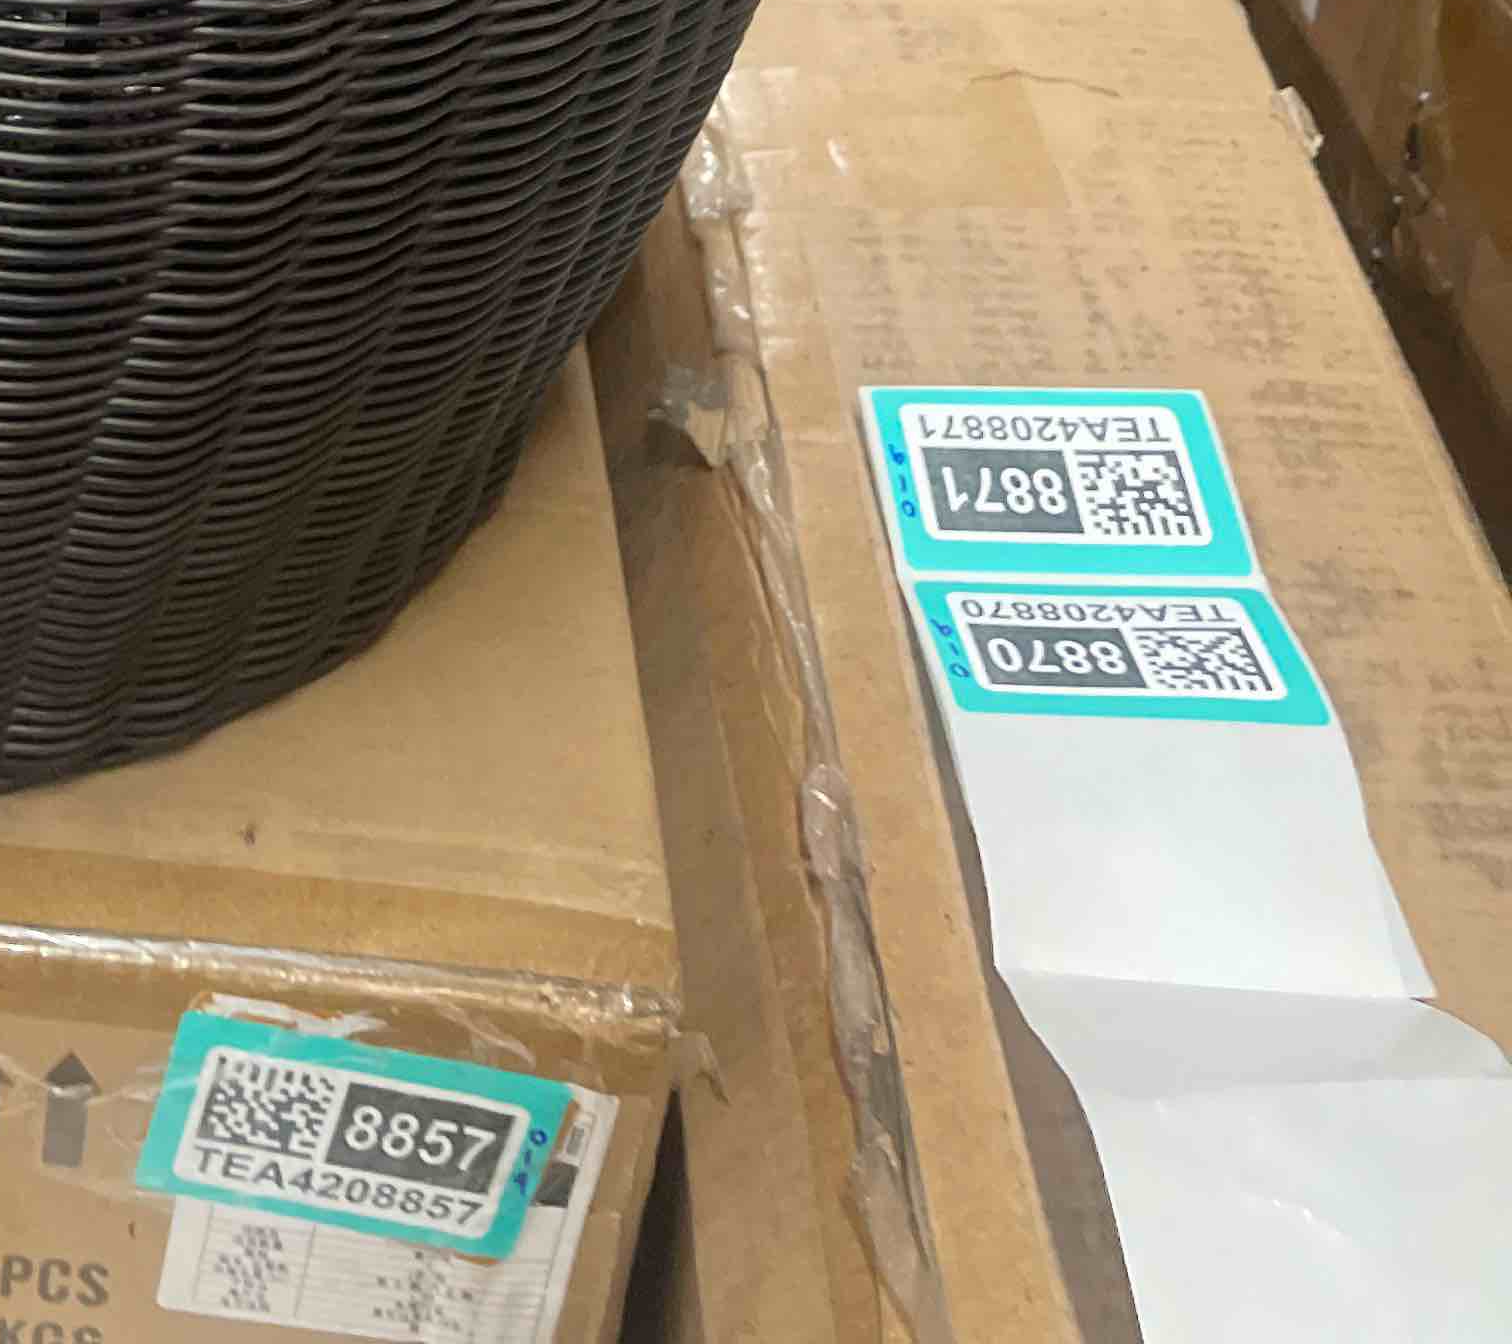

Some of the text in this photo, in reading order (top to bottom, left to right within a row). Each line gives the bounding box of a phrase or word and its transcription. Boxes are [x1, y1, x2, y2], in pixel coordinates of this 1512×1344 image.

[919, 414, 1172, 443] TEA4208871
[940, 465, 1067, 515] 8871
[962, 599, 1237, 624] TEA4208870
[988, 637, 1128, 676] 8870
[342, 1103, 498, 1176] 8857
[193, 1147, 485, 1228] TEA4208857
[0, 1253, 111, 1307] PCS
